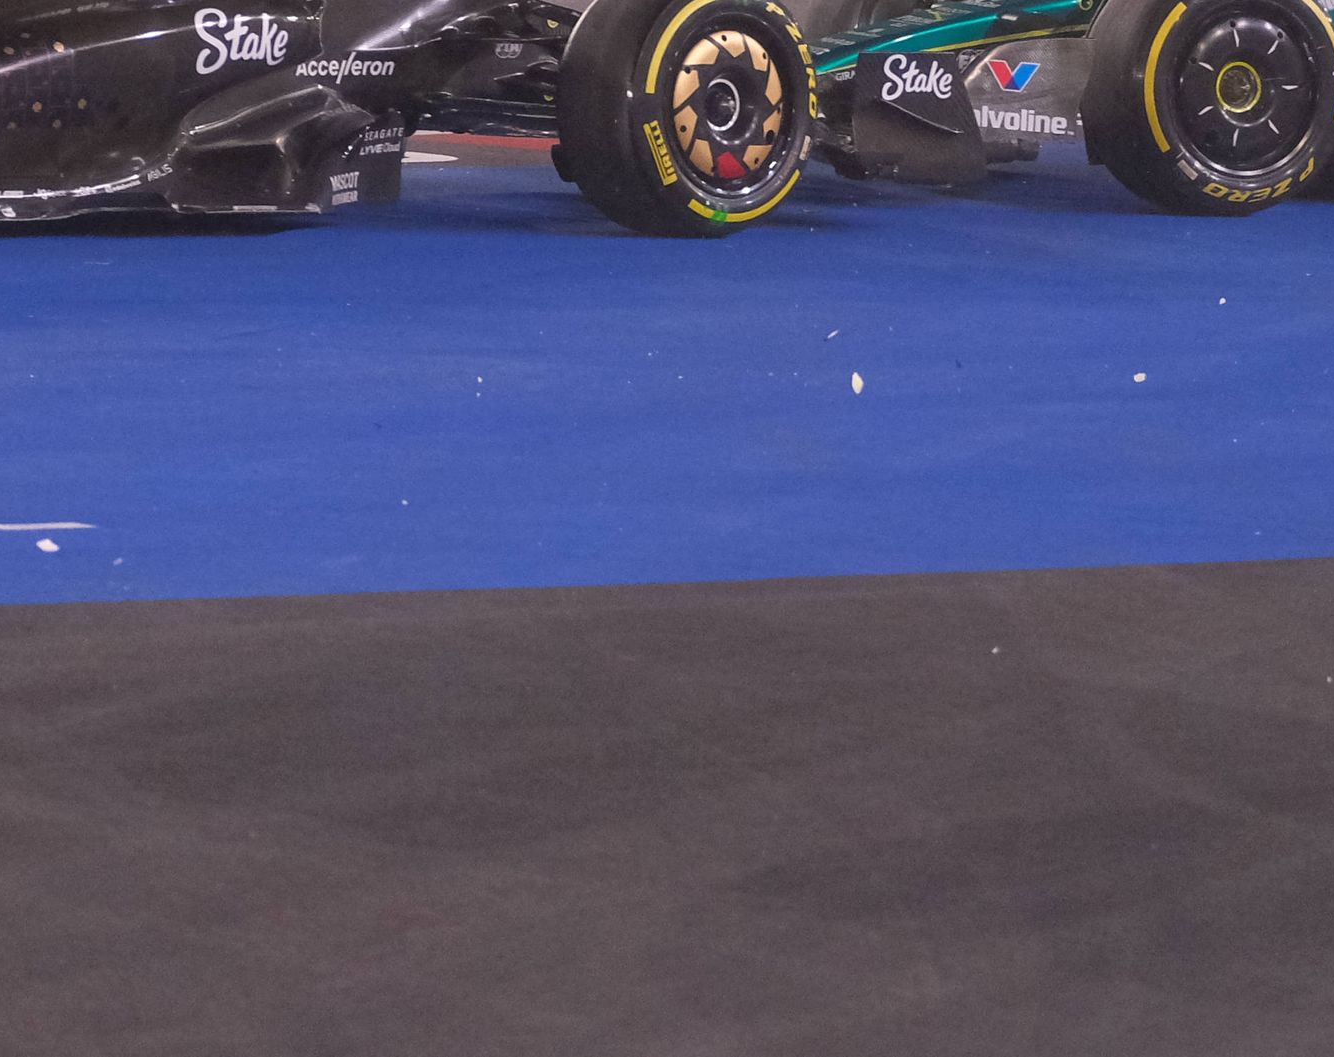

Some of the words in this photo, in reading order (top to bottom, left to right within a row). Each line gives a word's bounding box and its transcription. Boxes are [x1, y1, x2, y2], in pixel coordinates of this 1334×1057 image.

[194, 7, 290, 75] Stake
[295, 51, 395, 84] Accelleron
[881, 53, 954, 102] Stake
[364, 127, 405, 142] SEAGATE
[973, 105, 1068, 135] lvoline
[642, 119, 678, 186] PIRELLI
[1202, 176, 1294, 204] ZERO
